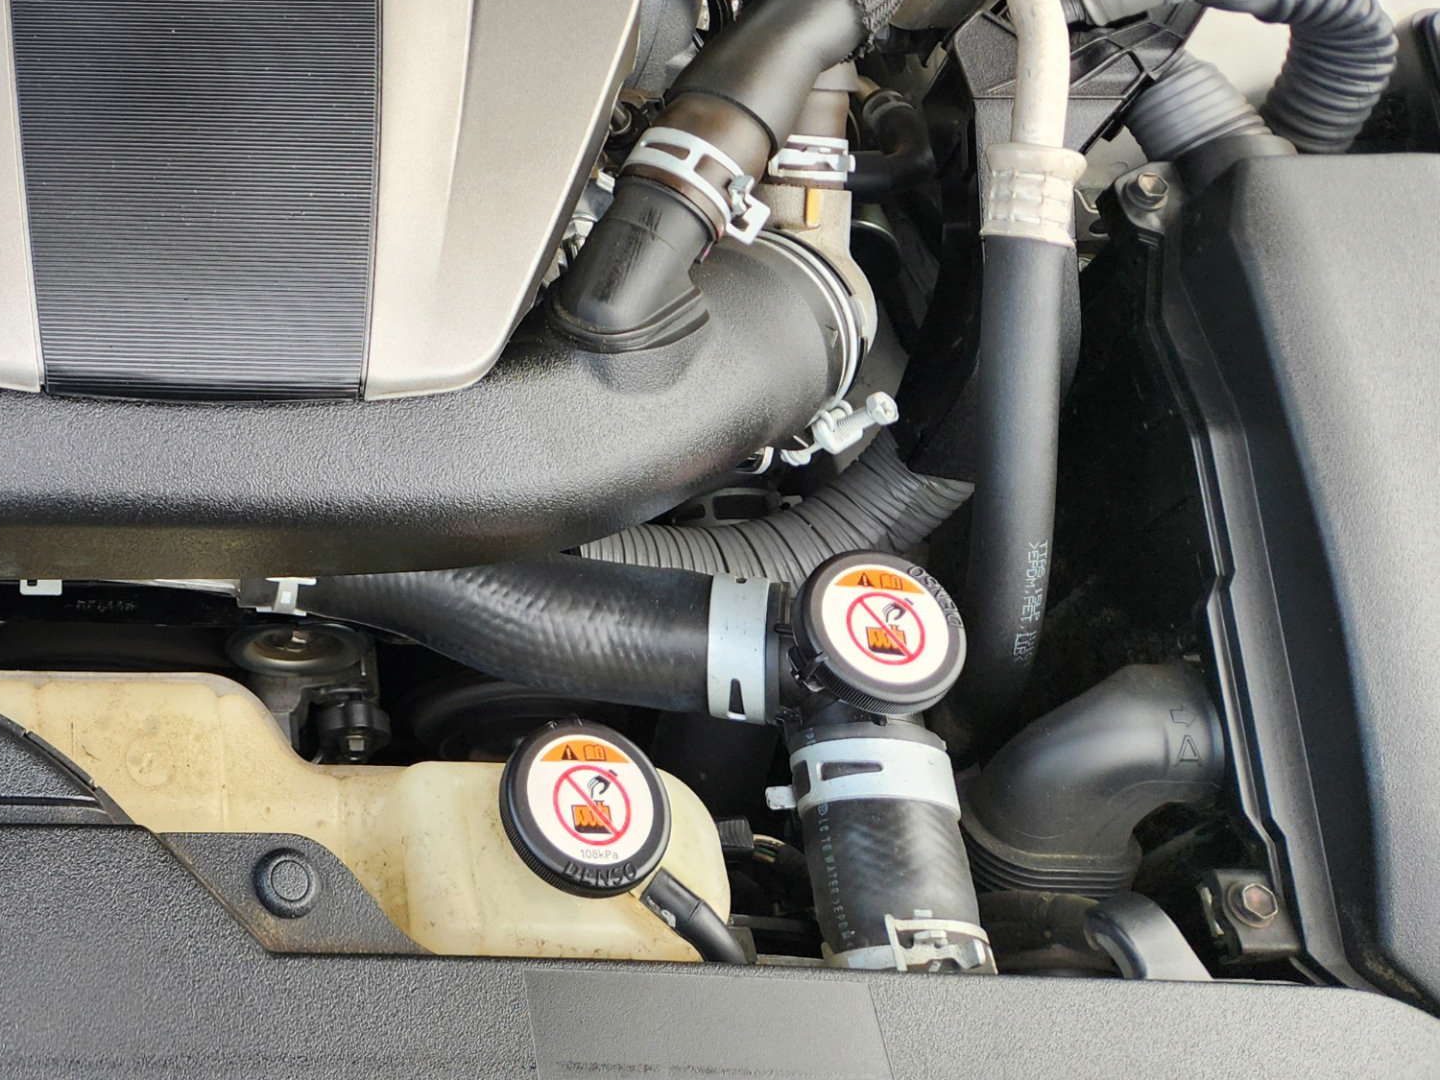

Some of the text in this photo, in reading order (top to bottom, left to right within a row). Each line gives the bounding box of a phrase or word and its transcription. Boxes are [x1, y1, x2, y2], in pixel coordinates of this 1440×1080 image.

[906, 565, 965, 630] DENSO
[579, 848, 619, 860] 108kPa
[561, 861, 638, 886] DENSO
